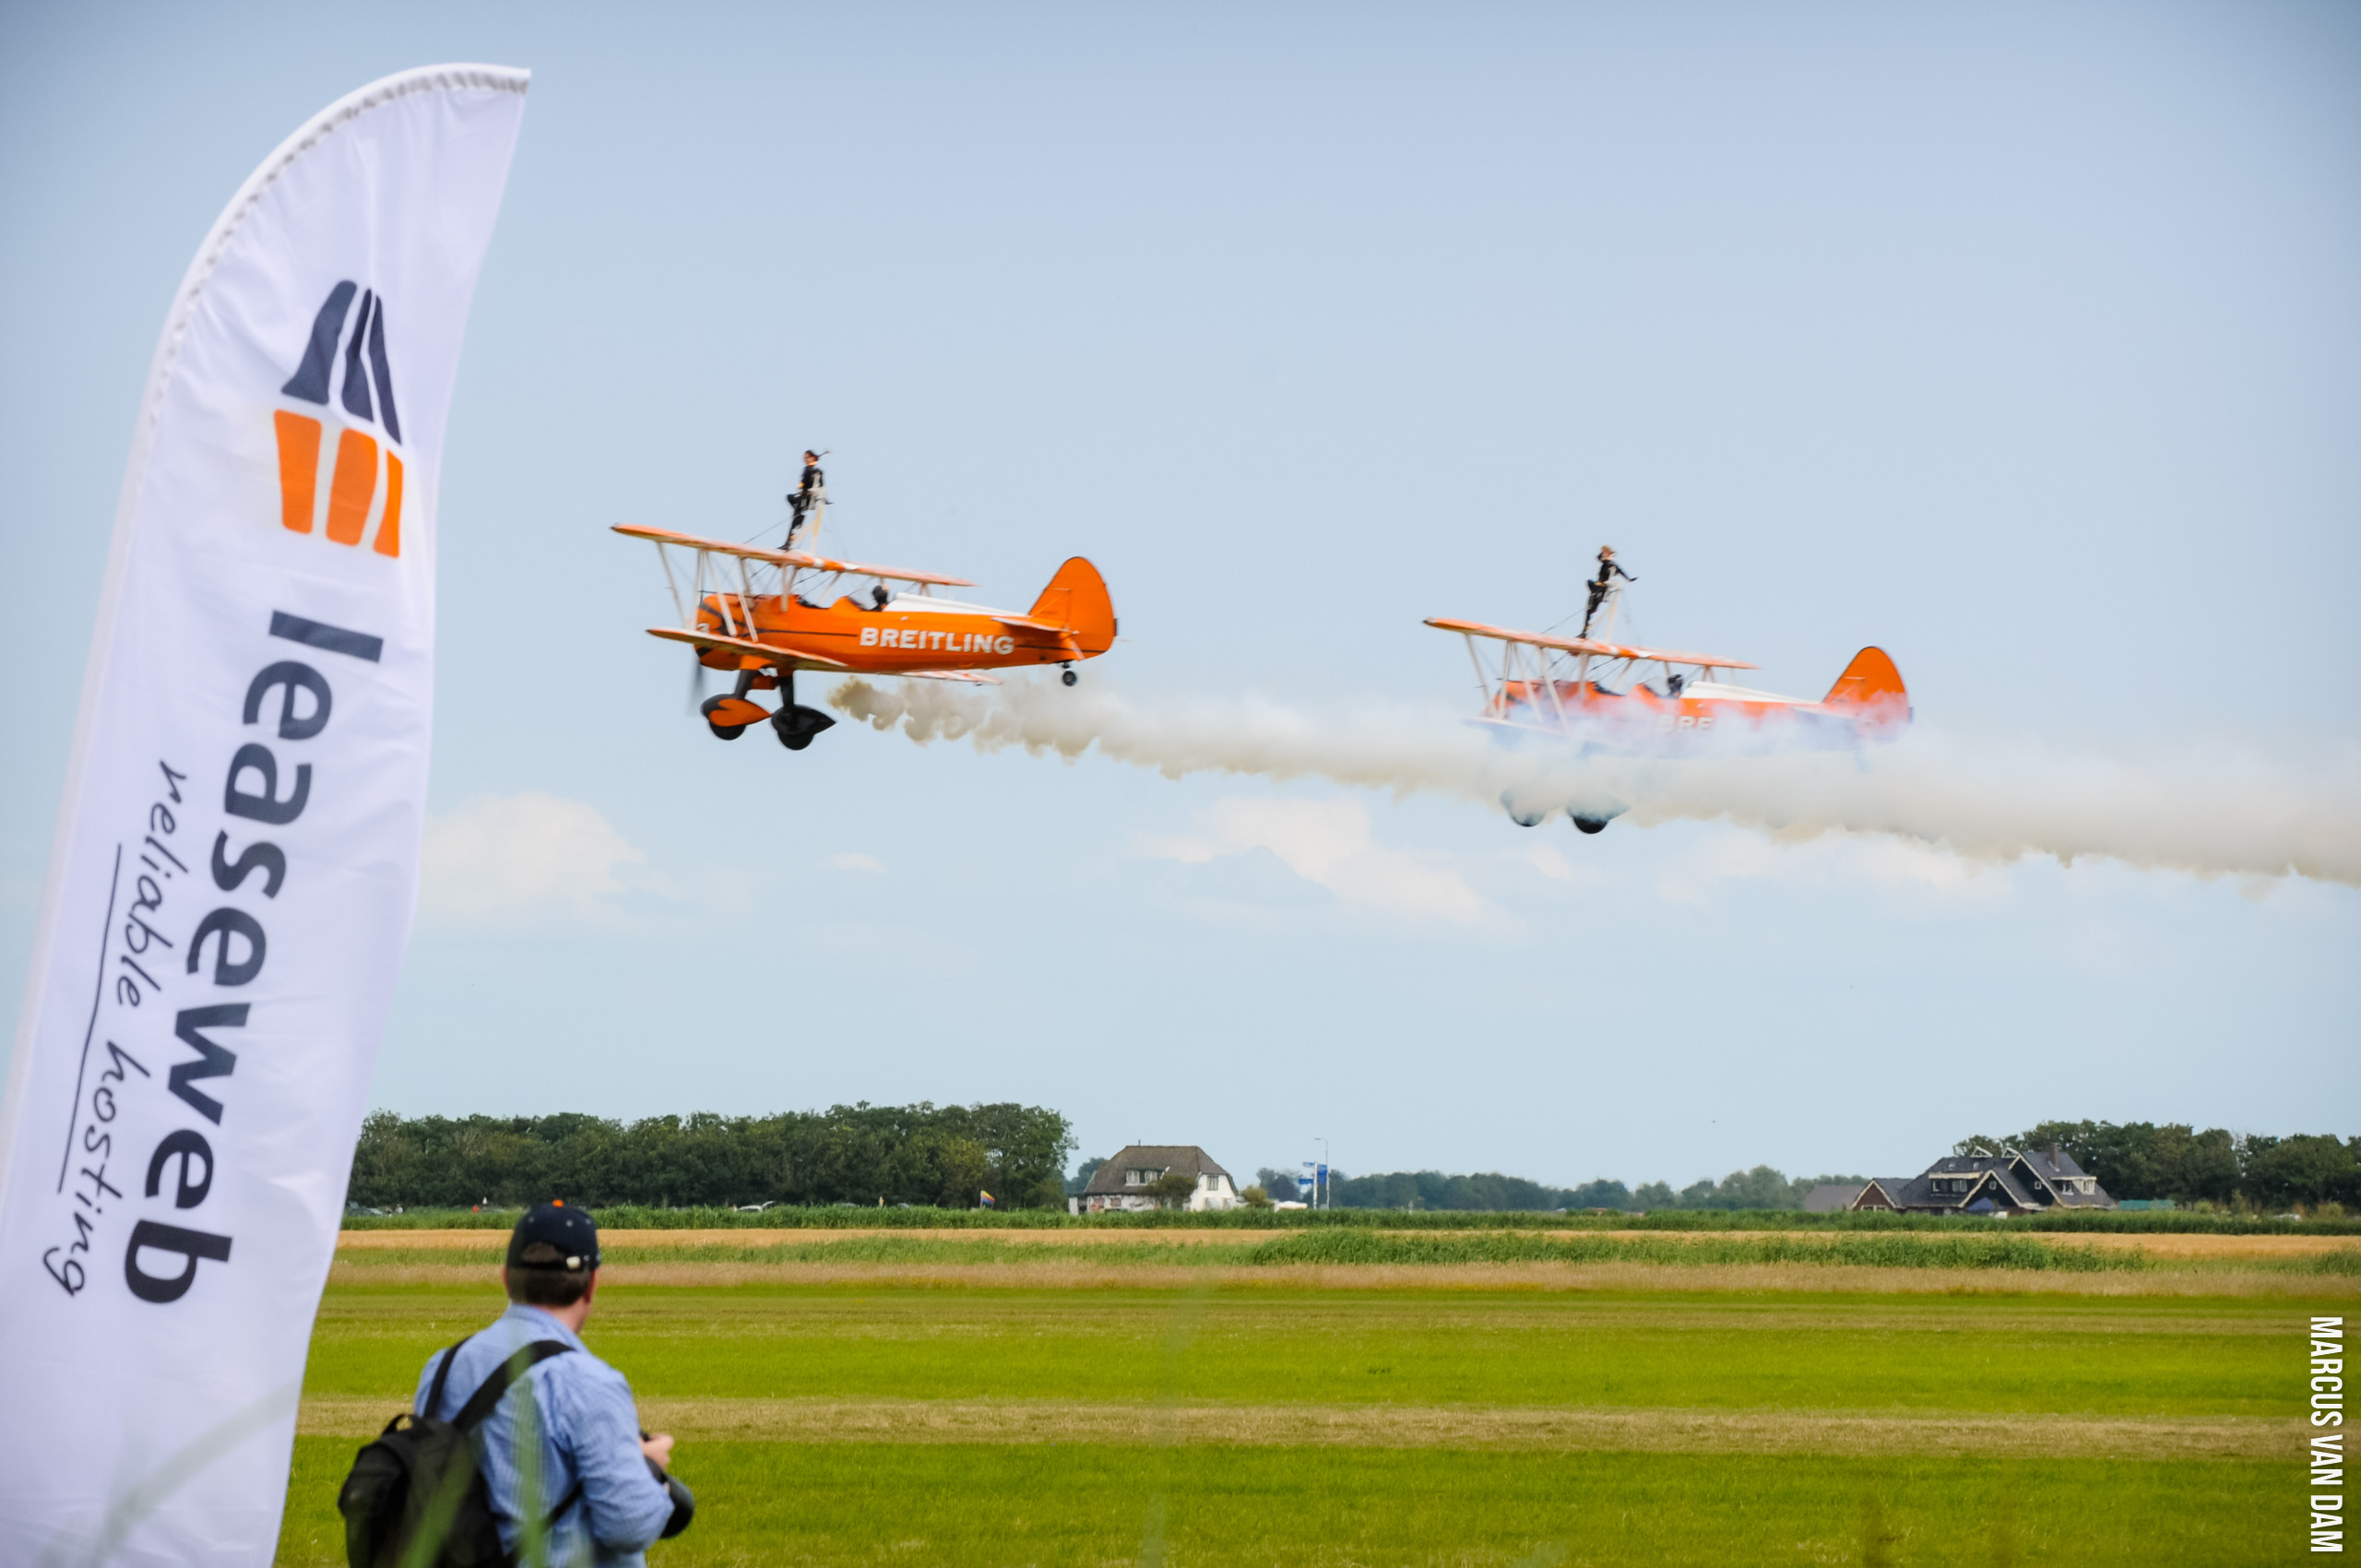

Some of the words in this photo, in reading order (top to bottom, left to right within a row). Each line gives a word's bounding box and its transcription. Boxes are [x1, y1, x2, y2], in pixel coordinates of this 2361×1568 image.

[860, 626, 1014, 655] BREITLING
[116, 759, 189, 1008] reliable
[125, 610, 385, 1305] leaseweb
[42, 1039, 151, 1297] hosting
